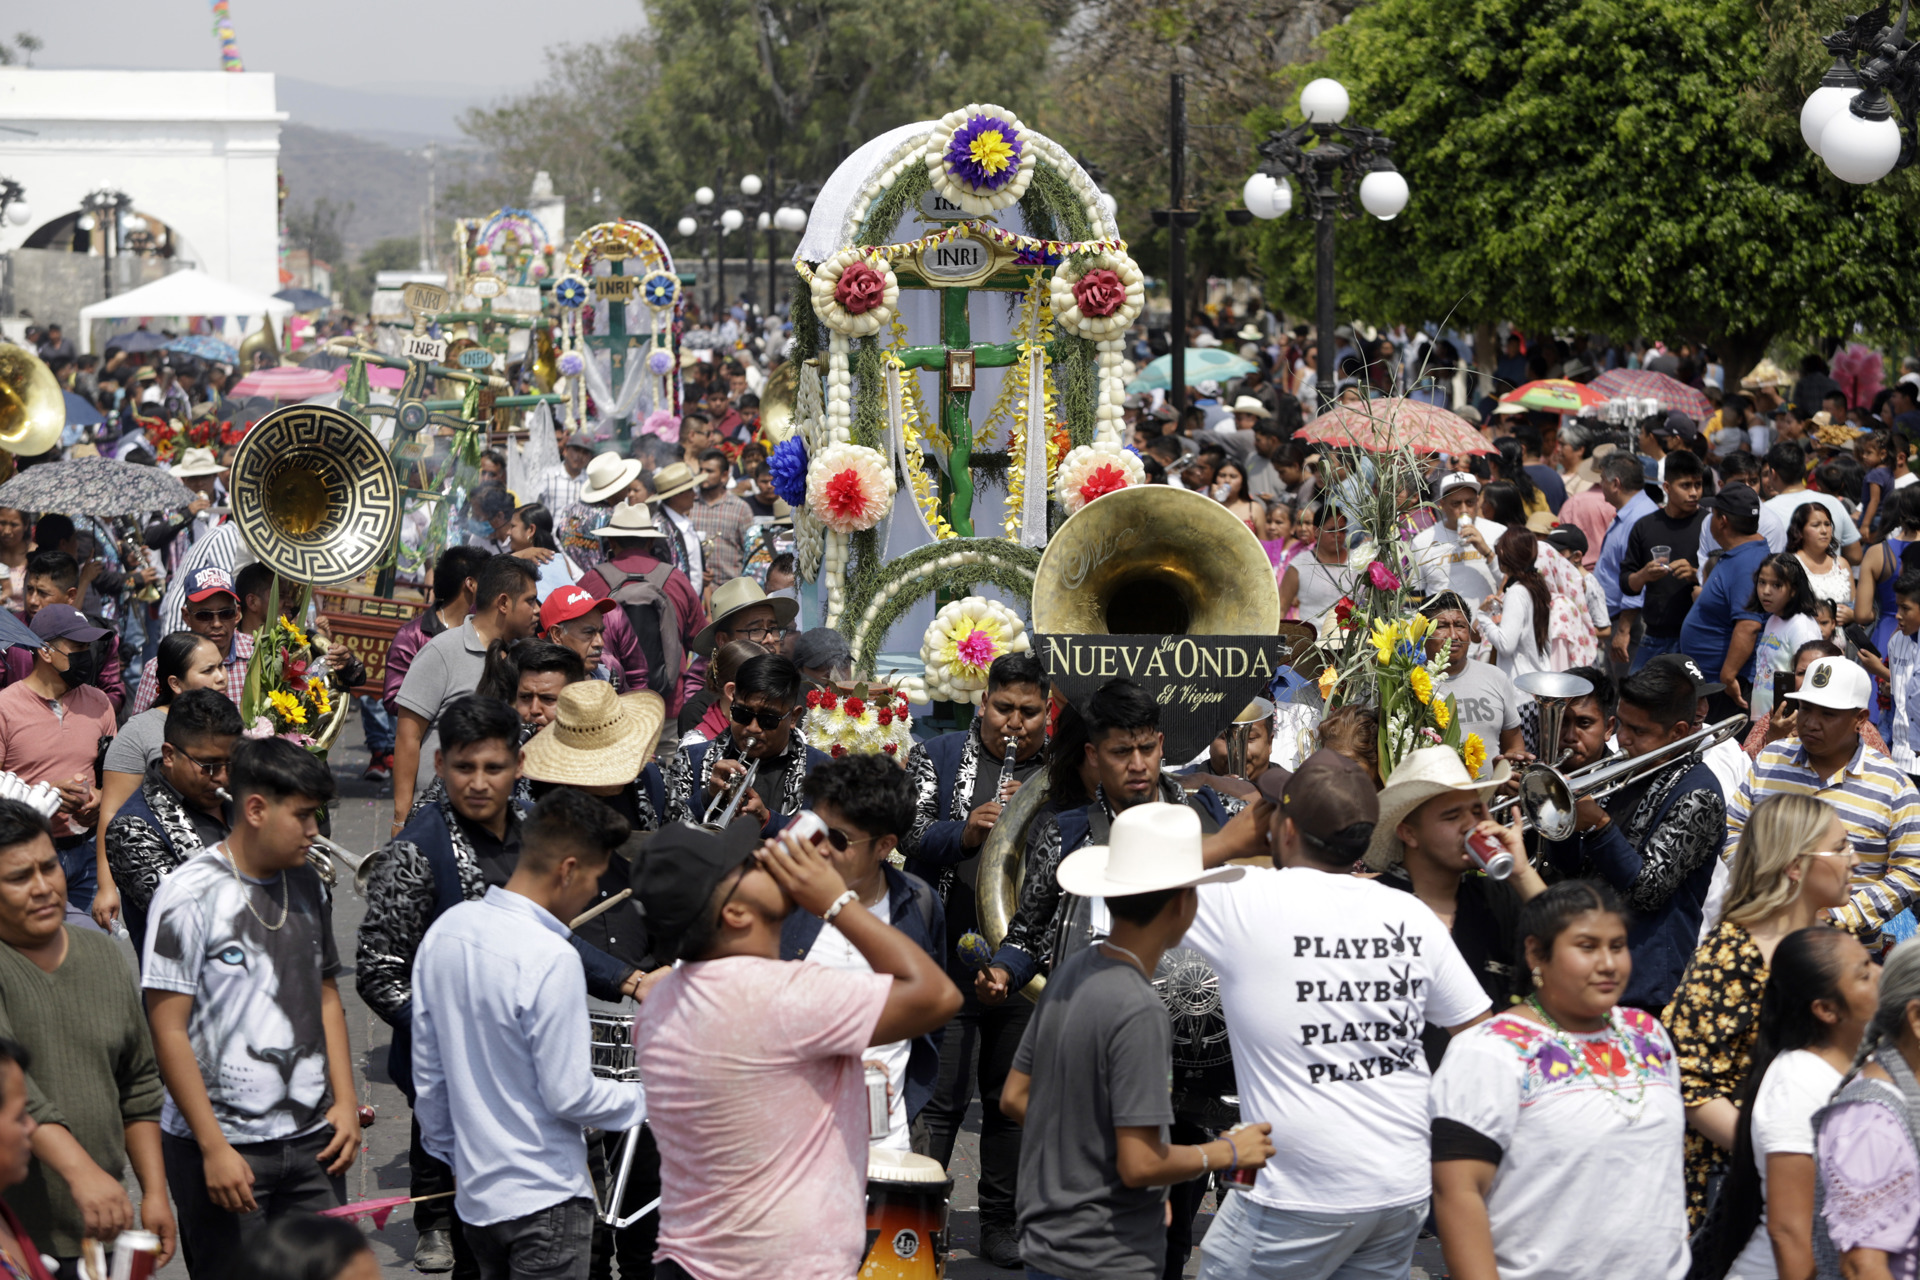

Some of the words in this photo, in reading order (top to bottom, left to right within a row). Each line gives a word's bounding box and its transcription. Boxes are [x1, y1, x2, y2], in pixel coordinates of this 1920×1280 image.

[937, 247, 977, 266] INRI
[600, 281, 630, 295] INRI
[413, 288, 441, 310] INRI
[409, 340, 440, 358] INRI
[464, 351, 489, 366] INRI
[1437, 550, 1486, 566] STARBO
[194, 567, 232, 588] BOSTON
[334, 634, 392, 653] SQUI
[1159, 634, 1177, 653] La
[1046, 637, 1169, 676] NUEVA
[1174, 638, 1273, 678] ONDA
[1156, 684, 1174, 705] El
[1179, 683, 1228, 713] Viejon
[898, 1236, 915, 1252] LP
